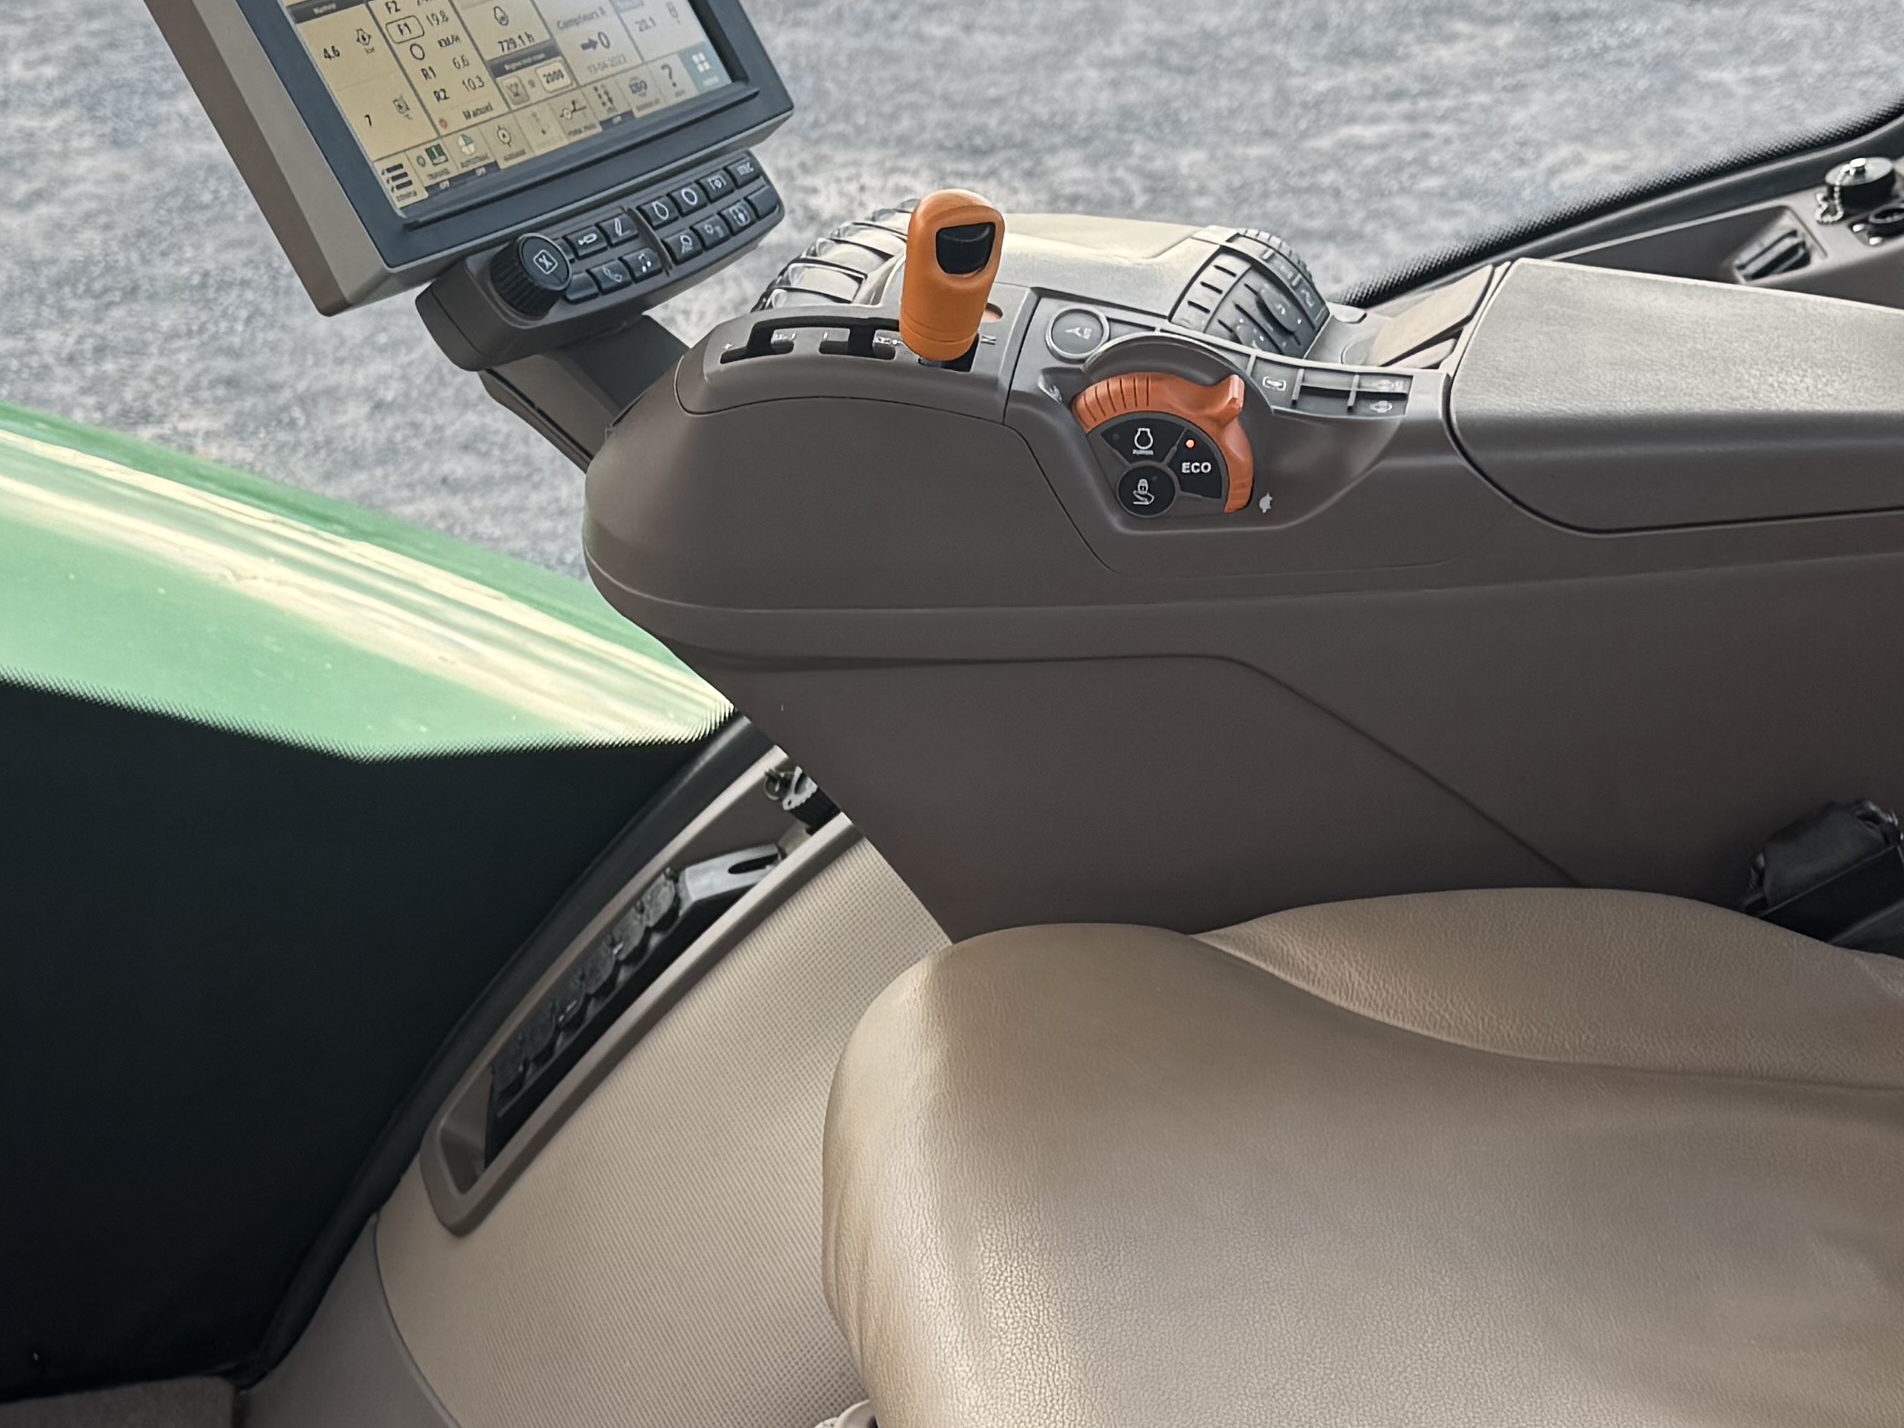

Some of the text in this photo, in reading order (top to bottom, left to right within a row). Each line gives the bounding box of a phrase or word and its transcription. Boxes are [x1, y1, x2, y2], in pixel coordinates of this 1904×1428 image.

[384, 0, 401, 15] F2
[396, 10, 450, 36] F1 19.8
[322, 44, 341, 61] 4.6
[420, 54, 471, 82] R1 6.6
[432, 75, 485, 103] R2 10.3
[462, 102, 495, 121] Manuel
[1181, 461, 1212, 474] ECO
